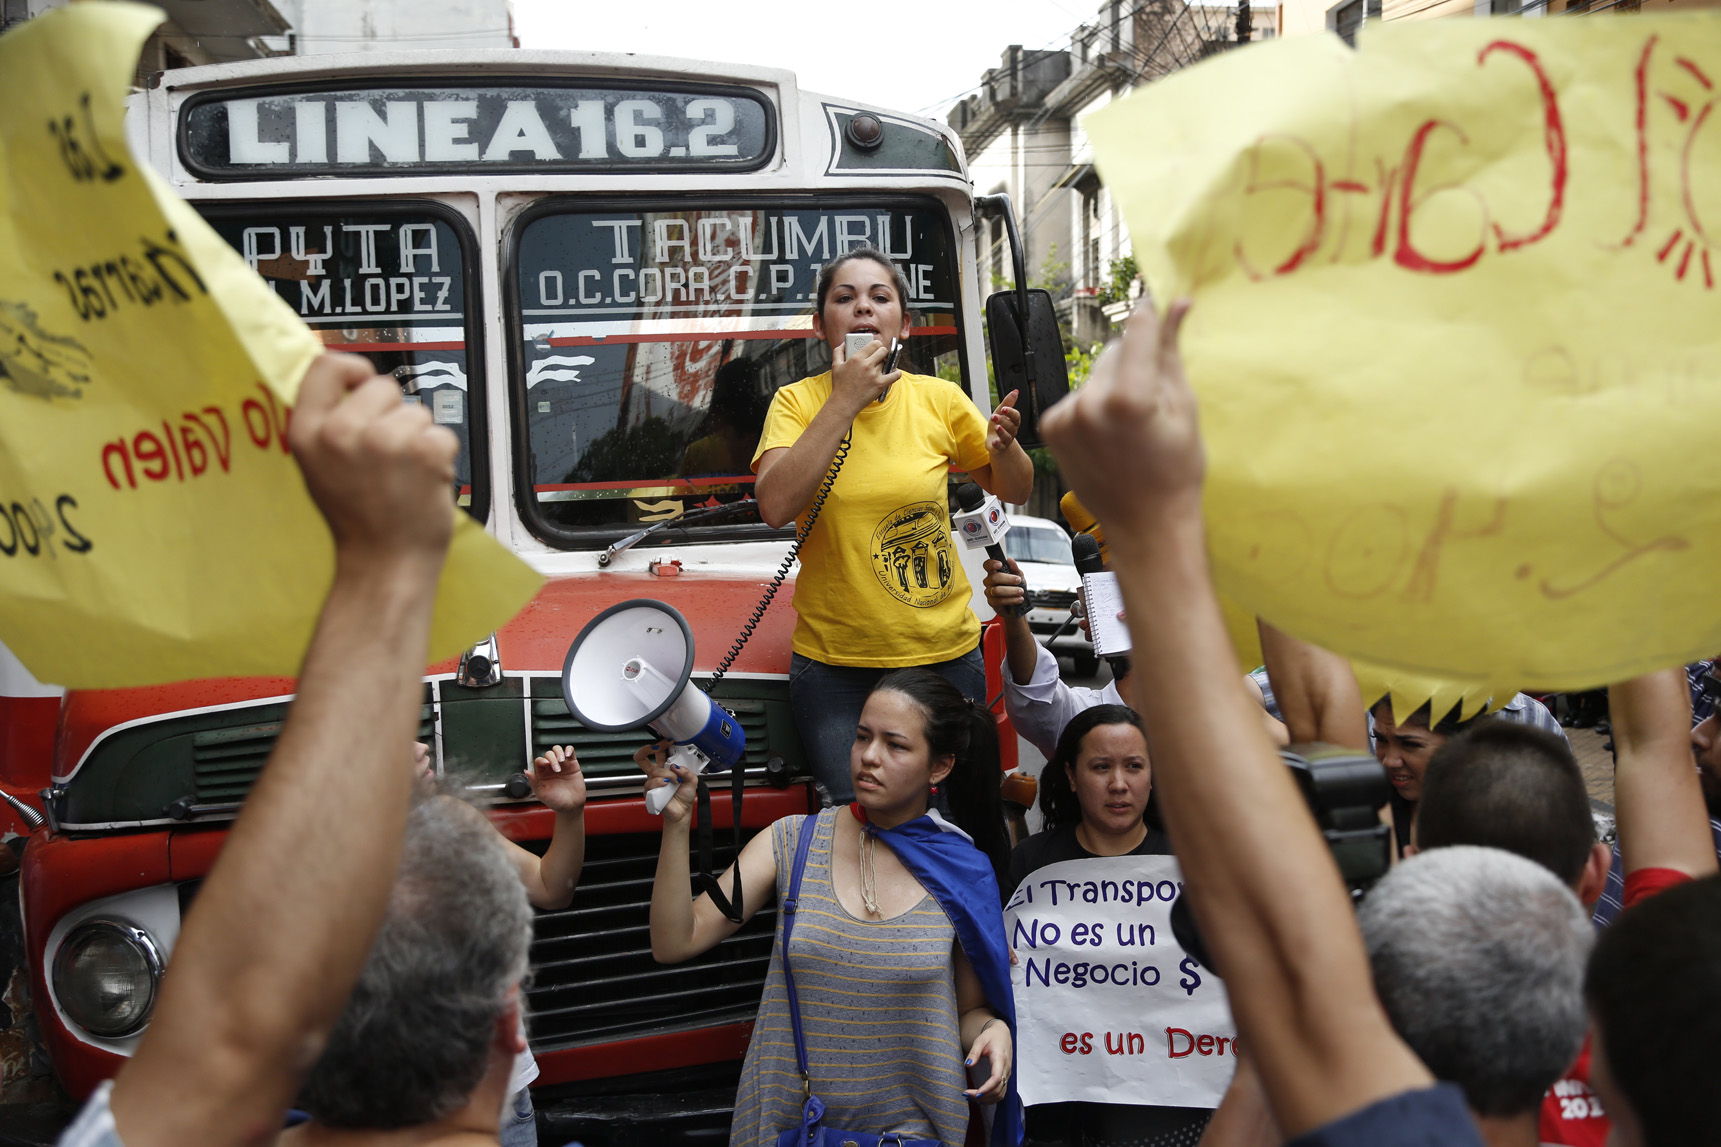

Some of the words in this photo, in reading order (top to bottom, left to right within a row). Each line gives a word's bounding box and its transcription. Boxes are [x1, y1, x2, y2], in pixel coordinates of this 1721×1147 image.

[228, 100, 563, 164] LINEA
[571, 100, 739, 160] 16.2
[243, 223, 441, 276] PYTA
[592, 215, 913, 264] TACUMBU
[878, 570, 912, 603] Universidad
[1013, 919, 1061, 949] No
[1071, 922, 1104, 946] es
[1117, 923, 1155, 946] un
[1026, 957, 1161, 989] Negocio
[1060, 1031, 1094, 1055] es
[1104, 1031, 1145, 1055] un
